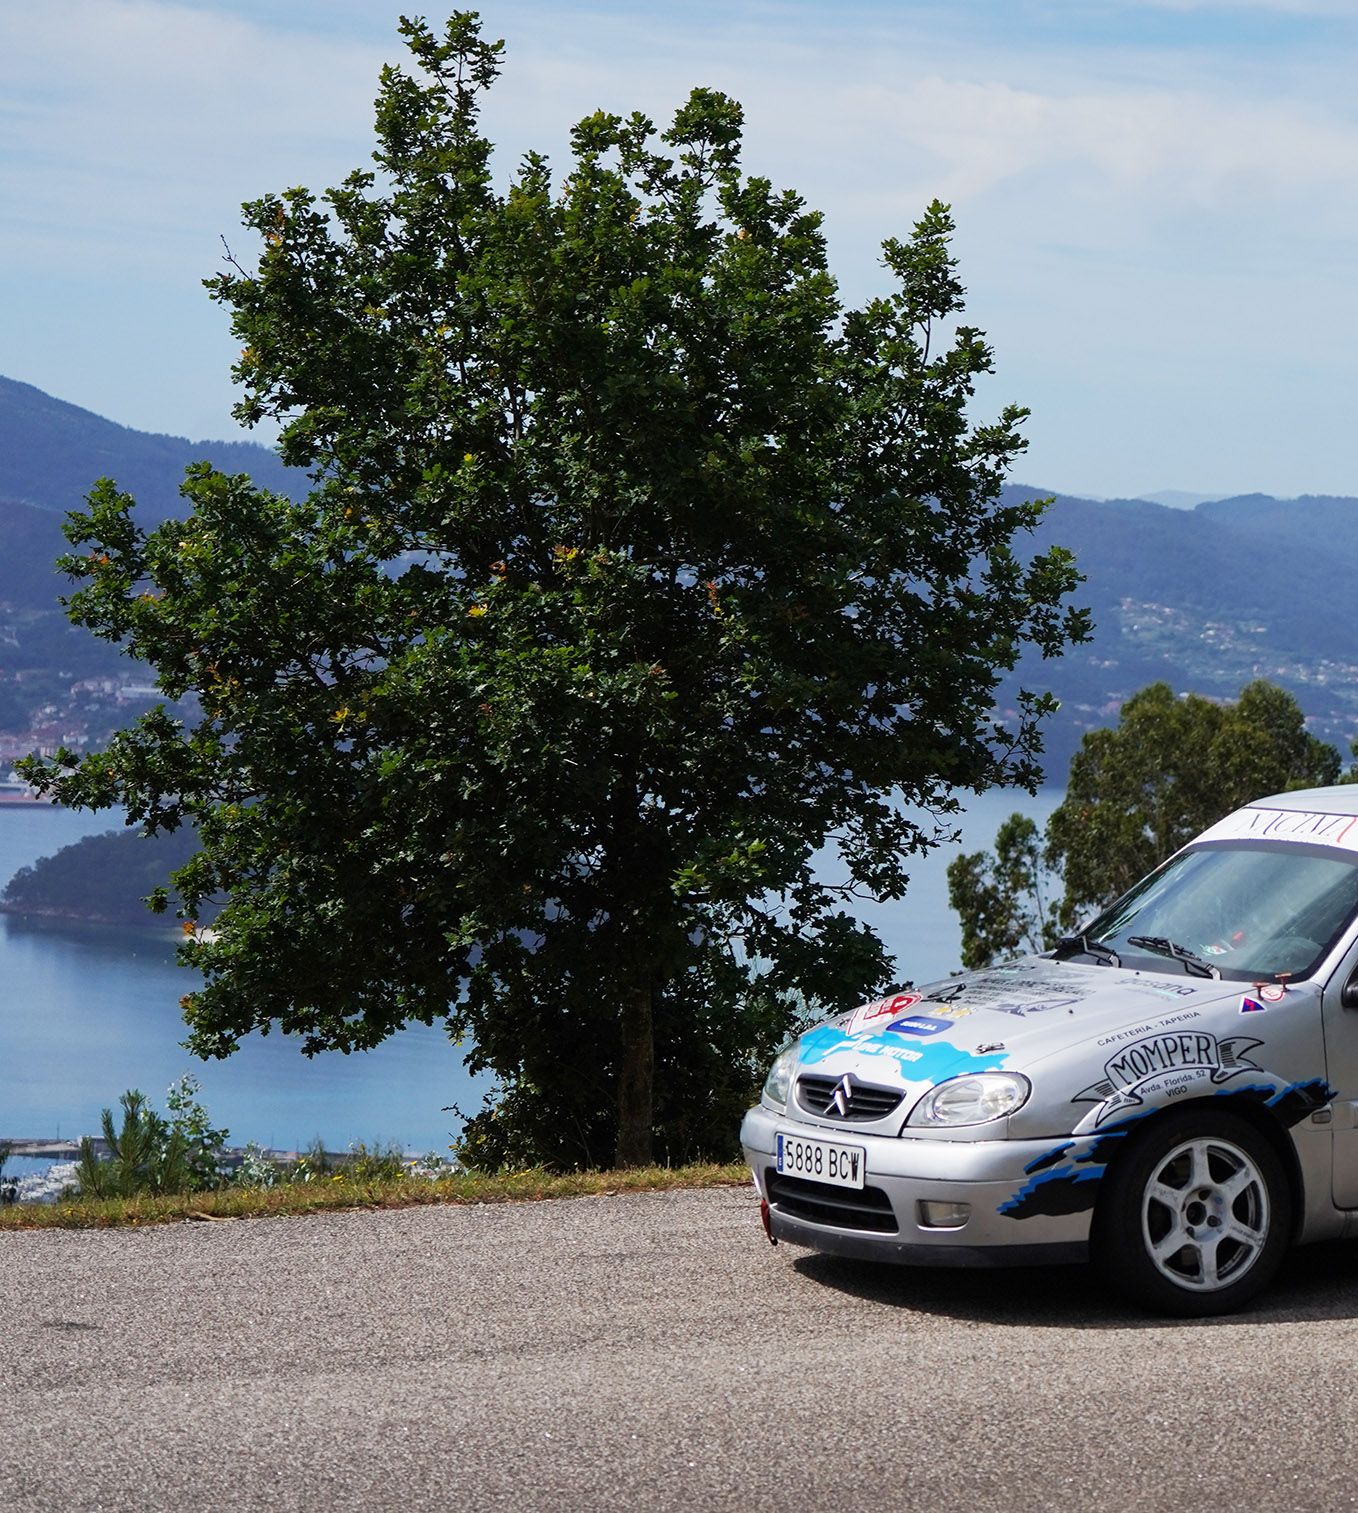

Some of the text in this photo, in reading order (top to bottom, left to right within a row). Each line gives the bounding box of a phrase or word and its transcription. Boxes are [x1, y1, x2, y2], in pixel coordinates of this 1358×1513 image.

[1111, 1034, 1214, 1086] MOMPER
[1196, 1069, 1207, 1079] 52
[1165, 1085, 1188, 1098] VIGO
[785, 1140, 860, 1182] 5888 BCW
